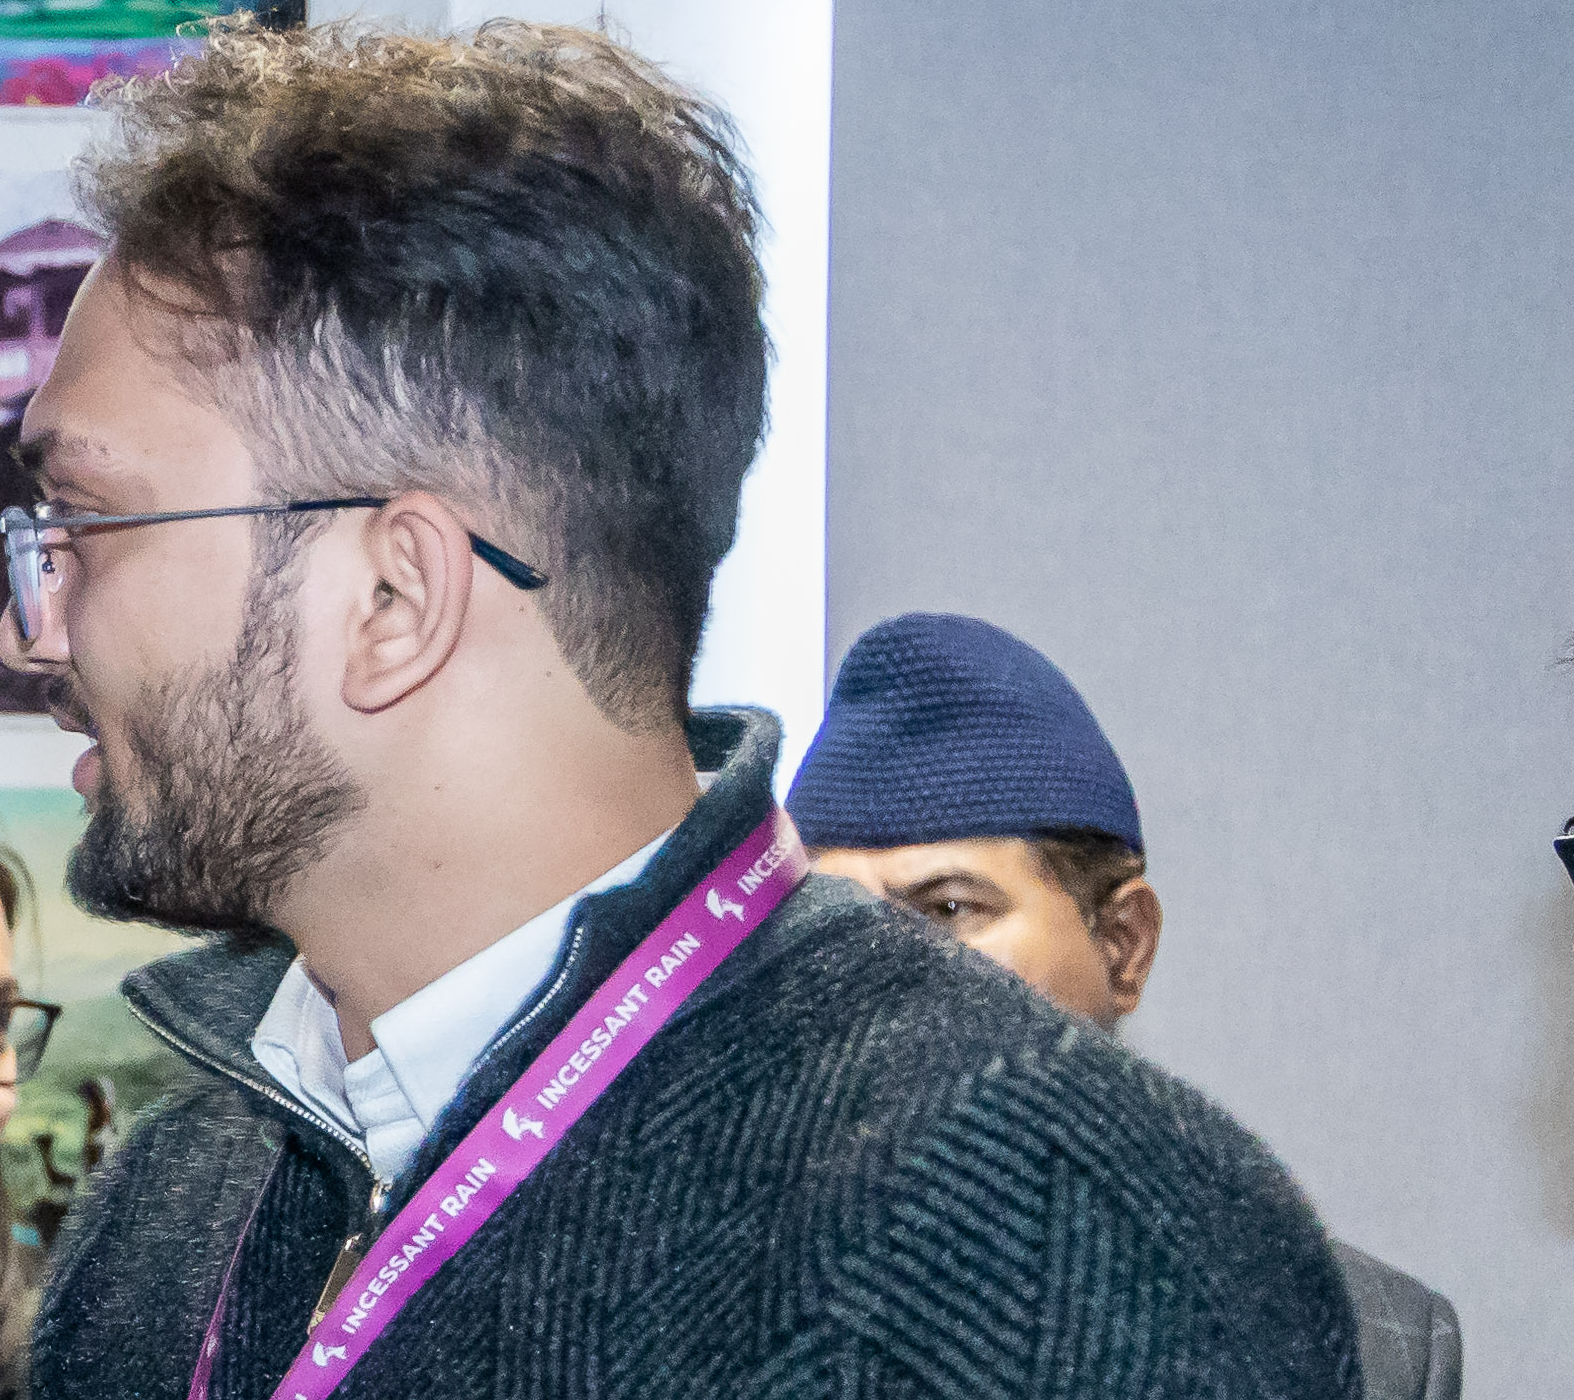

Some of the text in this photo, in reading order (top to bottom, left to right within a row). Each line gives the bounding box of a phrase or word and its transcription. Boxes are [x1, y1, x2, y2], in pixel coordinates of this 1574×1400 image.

[536, 932, 701, 1110] INCESSANT RAIN
[341, 1158, 497, 1334] INCESSANT RAIN
